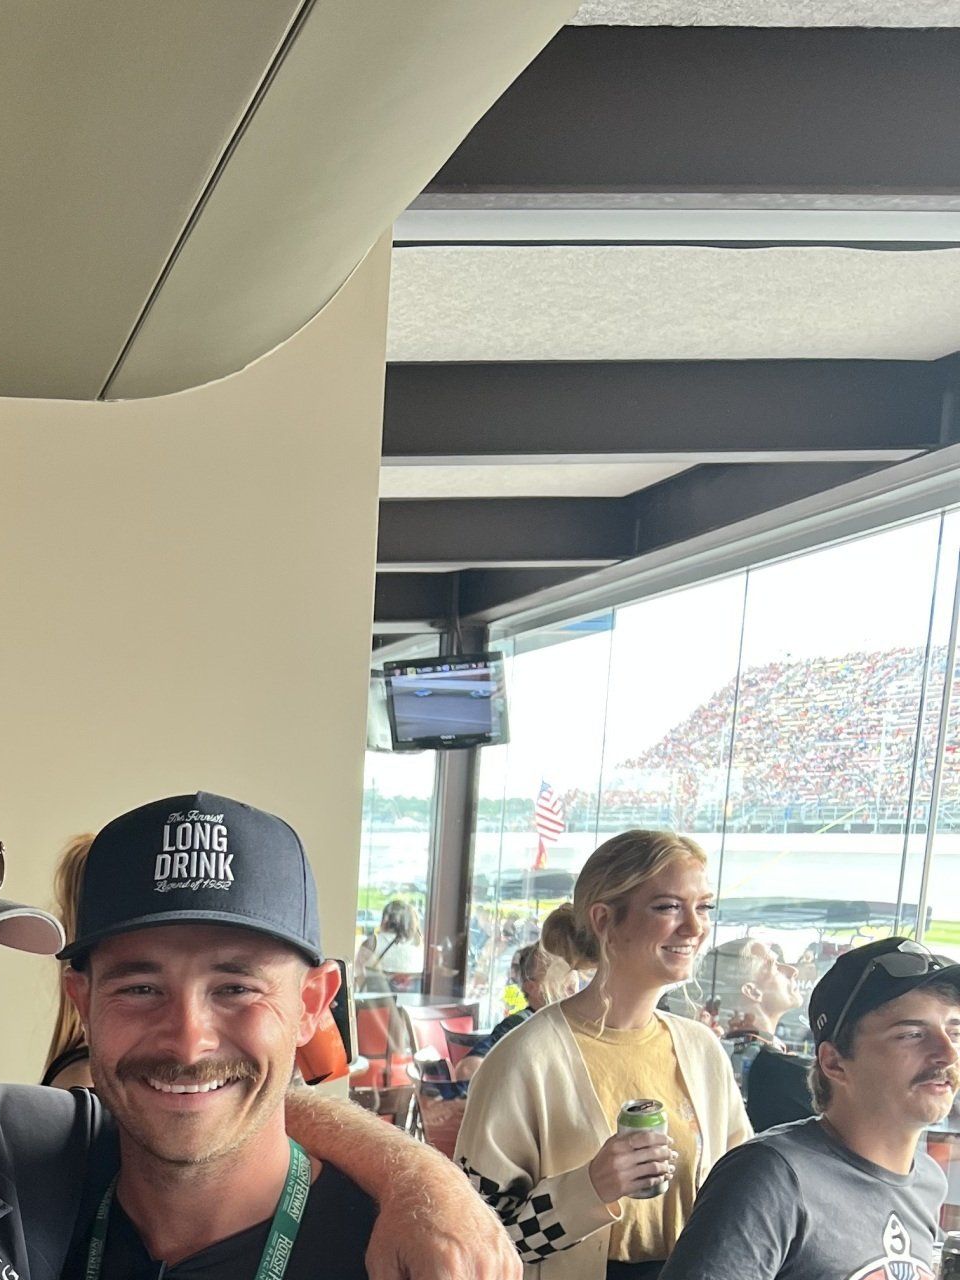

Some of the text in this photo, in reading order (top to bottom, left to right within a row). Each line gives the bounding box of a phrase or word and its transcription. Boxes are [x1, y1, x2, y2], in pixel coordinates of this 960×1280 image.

[163, 822, 228, 852] LONG
[154, 851, 235, 880] DRINK
[890, 1219, 906, 1254] 3
